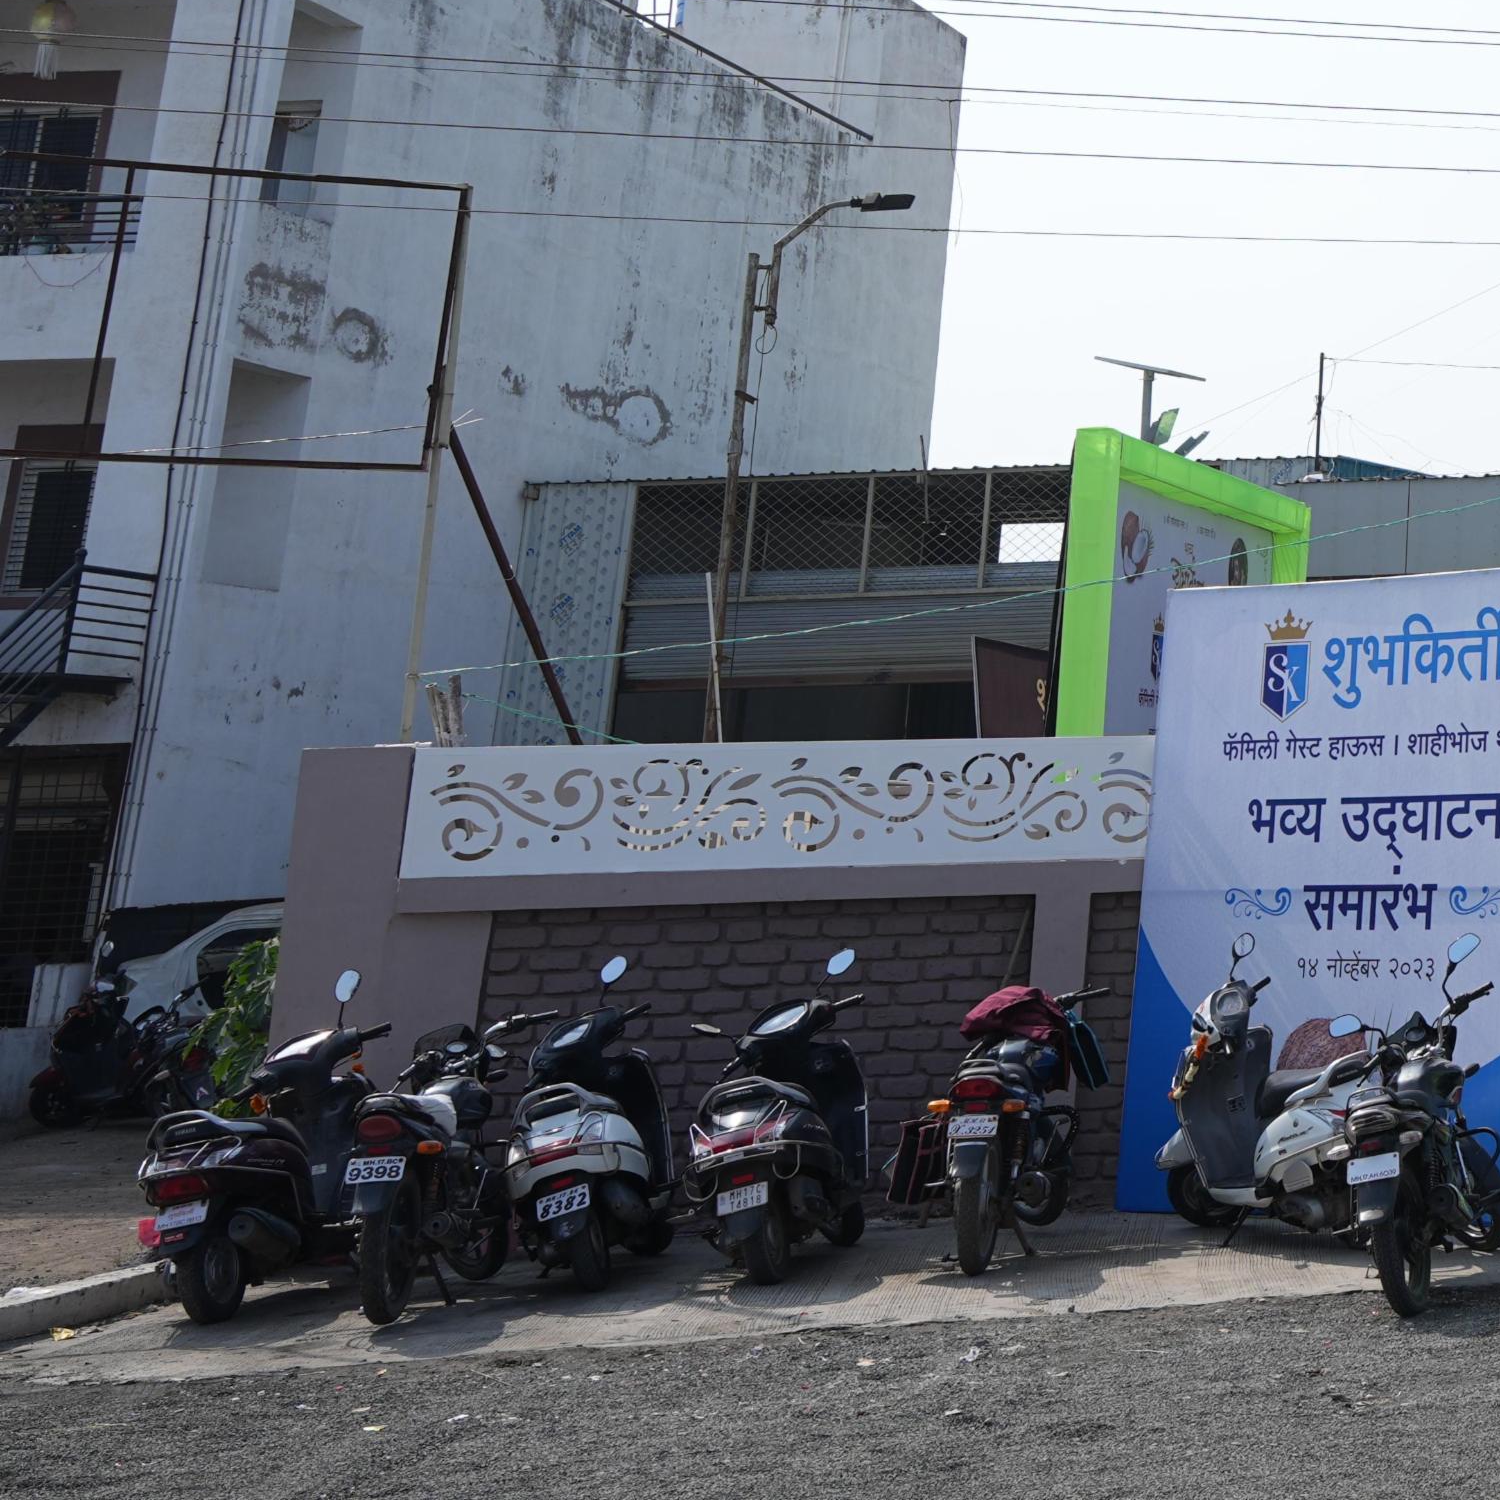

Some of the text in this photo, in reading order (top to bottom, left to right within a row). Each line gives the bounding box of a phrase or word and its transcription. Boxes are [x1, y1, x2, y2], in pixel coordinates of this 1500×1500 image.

[1222, 731, 1280, 761] फॅमिली
[1285, 729, 1323, 758] गेस्ट
[1328, 733, 1385, 760] हाऊस
[1406, 722, 1488, 757] शाहीभोज
[1247, 796, 1327, 844] भव्य
[1302, 864, 1438, 932] समारंभ
[1296, 949, 1437, 981] १४ नोव्हेंबर २०२३
[347, 1165, 402, 1182] 9398
[540, 1191, 587, 1220] 8382
